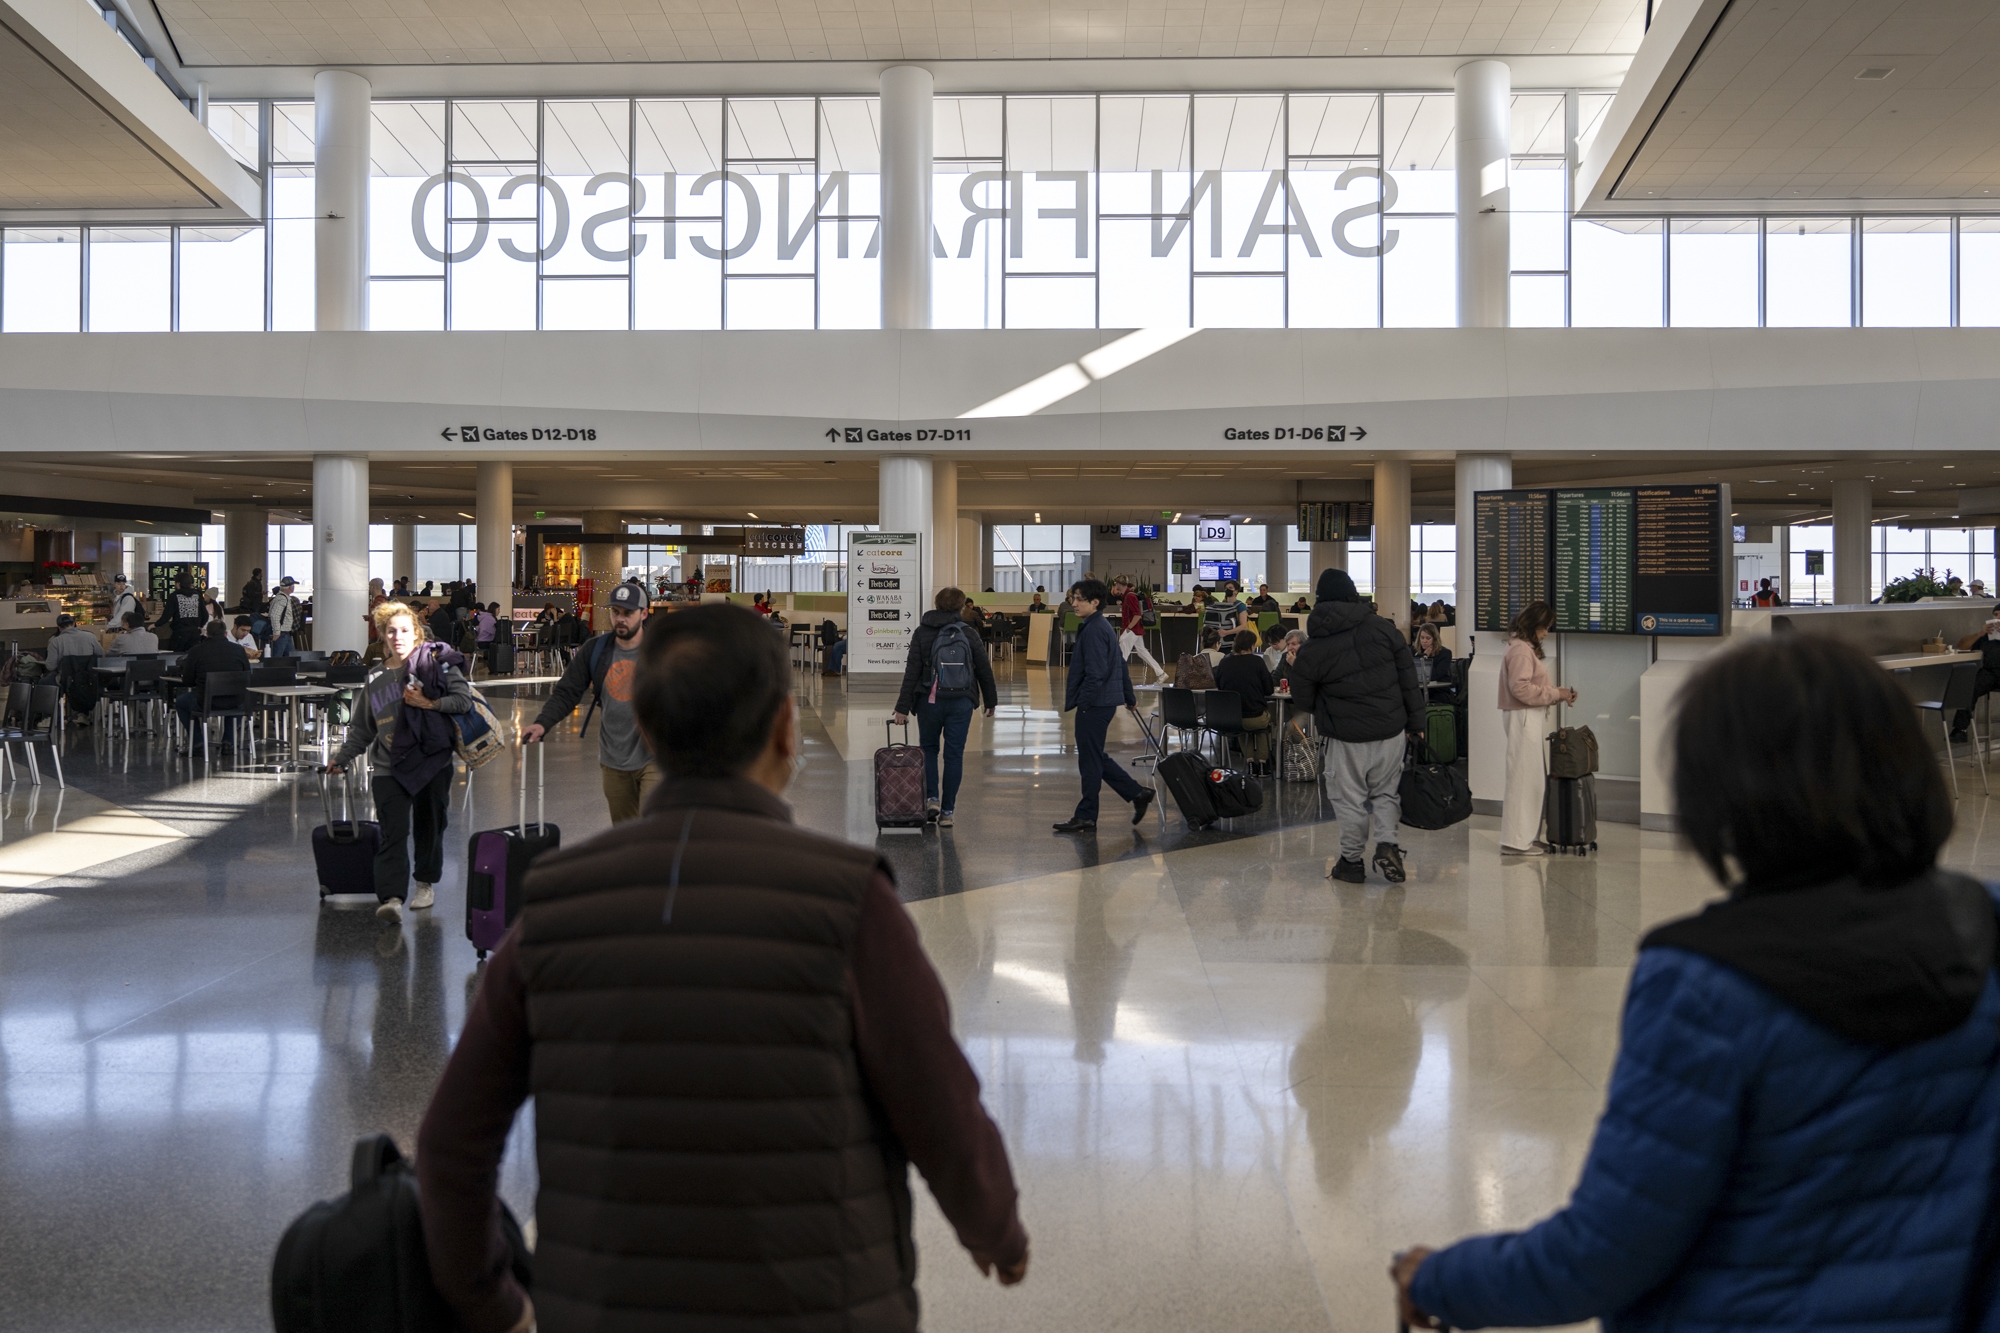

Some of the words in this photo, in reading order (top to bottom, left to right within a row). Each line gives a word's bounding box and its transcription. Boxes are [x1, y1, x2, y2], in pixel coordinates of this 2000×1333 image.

[483, 426, 528, 441] Gates
[531, 426, 597, 441] D12-D18
[867, 427, 912, 441] Gates
[916, 427, 972, 441] D7-D11
[1224, 427, 1270, 441] Gates
[1275, 426, 1324, 441] D1-D6
[1207, 527, 1226, 539] D9
[748, 541, 803, 549] KITCHEN
[883, 580, 898, 588] Coffee
[514, 610, 540, 619] catc
[883, 611, 898, 619] Coffee
